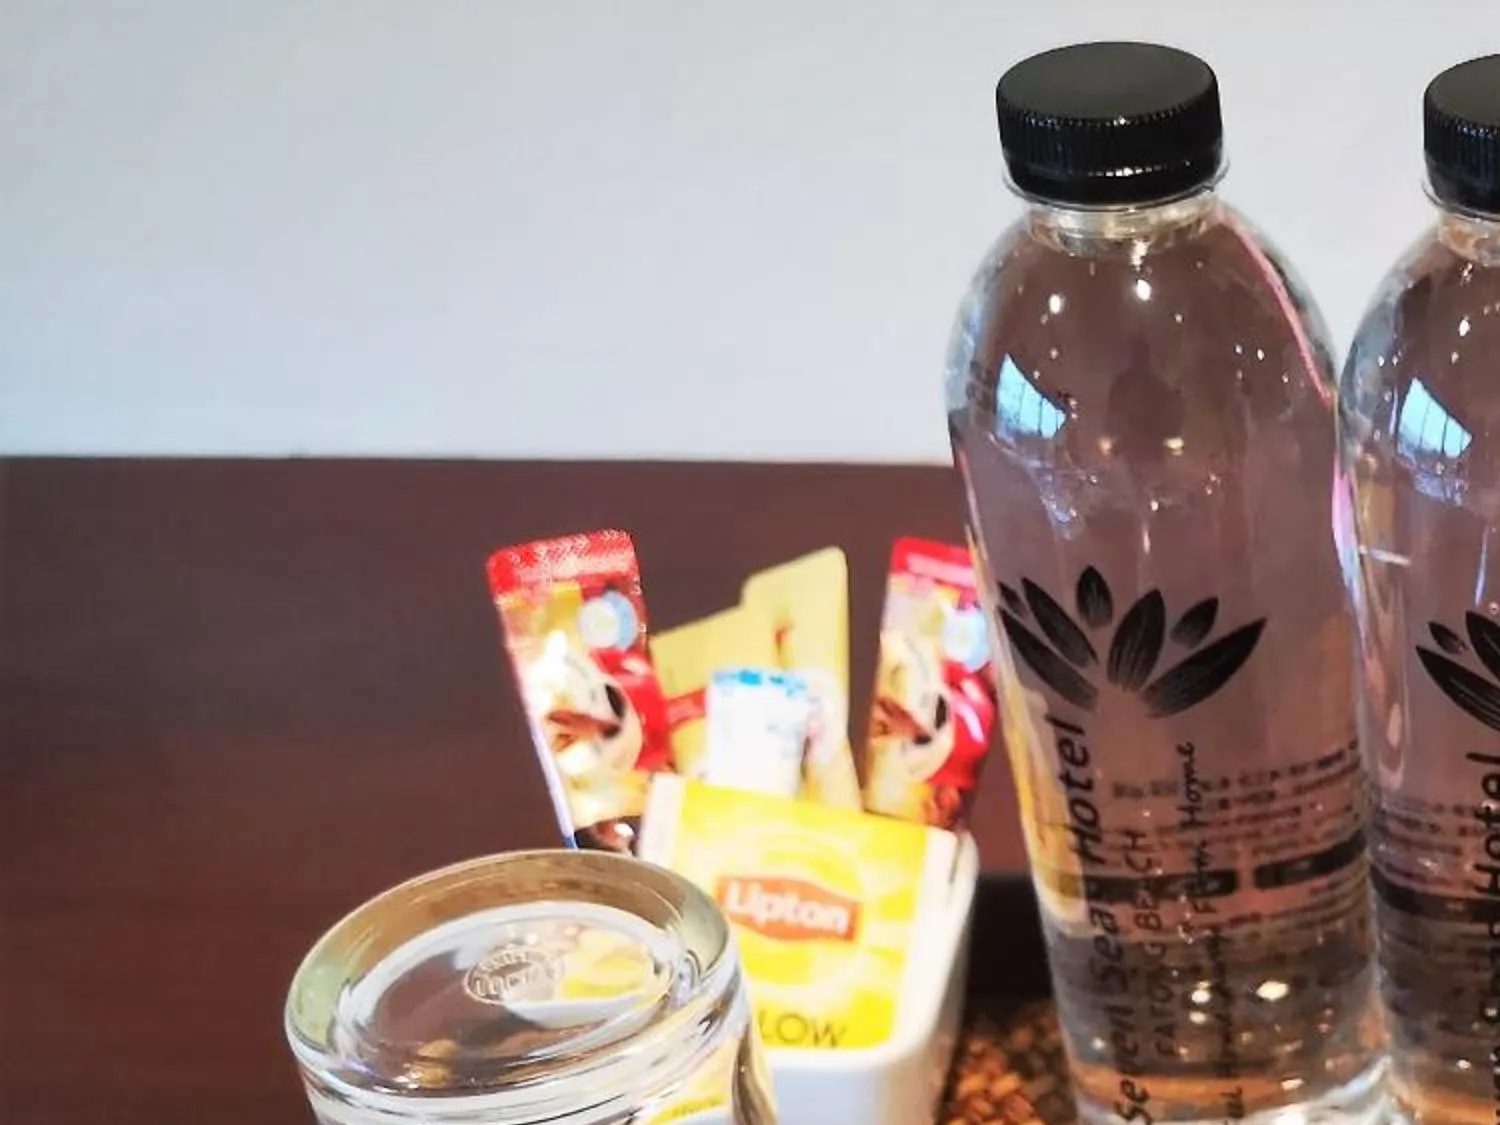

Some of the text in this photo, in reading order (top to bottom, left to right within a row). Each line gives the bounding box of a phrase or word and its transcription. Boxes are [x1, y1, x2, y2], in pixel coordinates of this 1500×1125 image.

[1044, 713, 1105, 867] Hotel
[726, 876, 851, 936] Lipton
[1123, 829, 1165, 935] BECH
[1086, 886, 1132, 998] Sea
